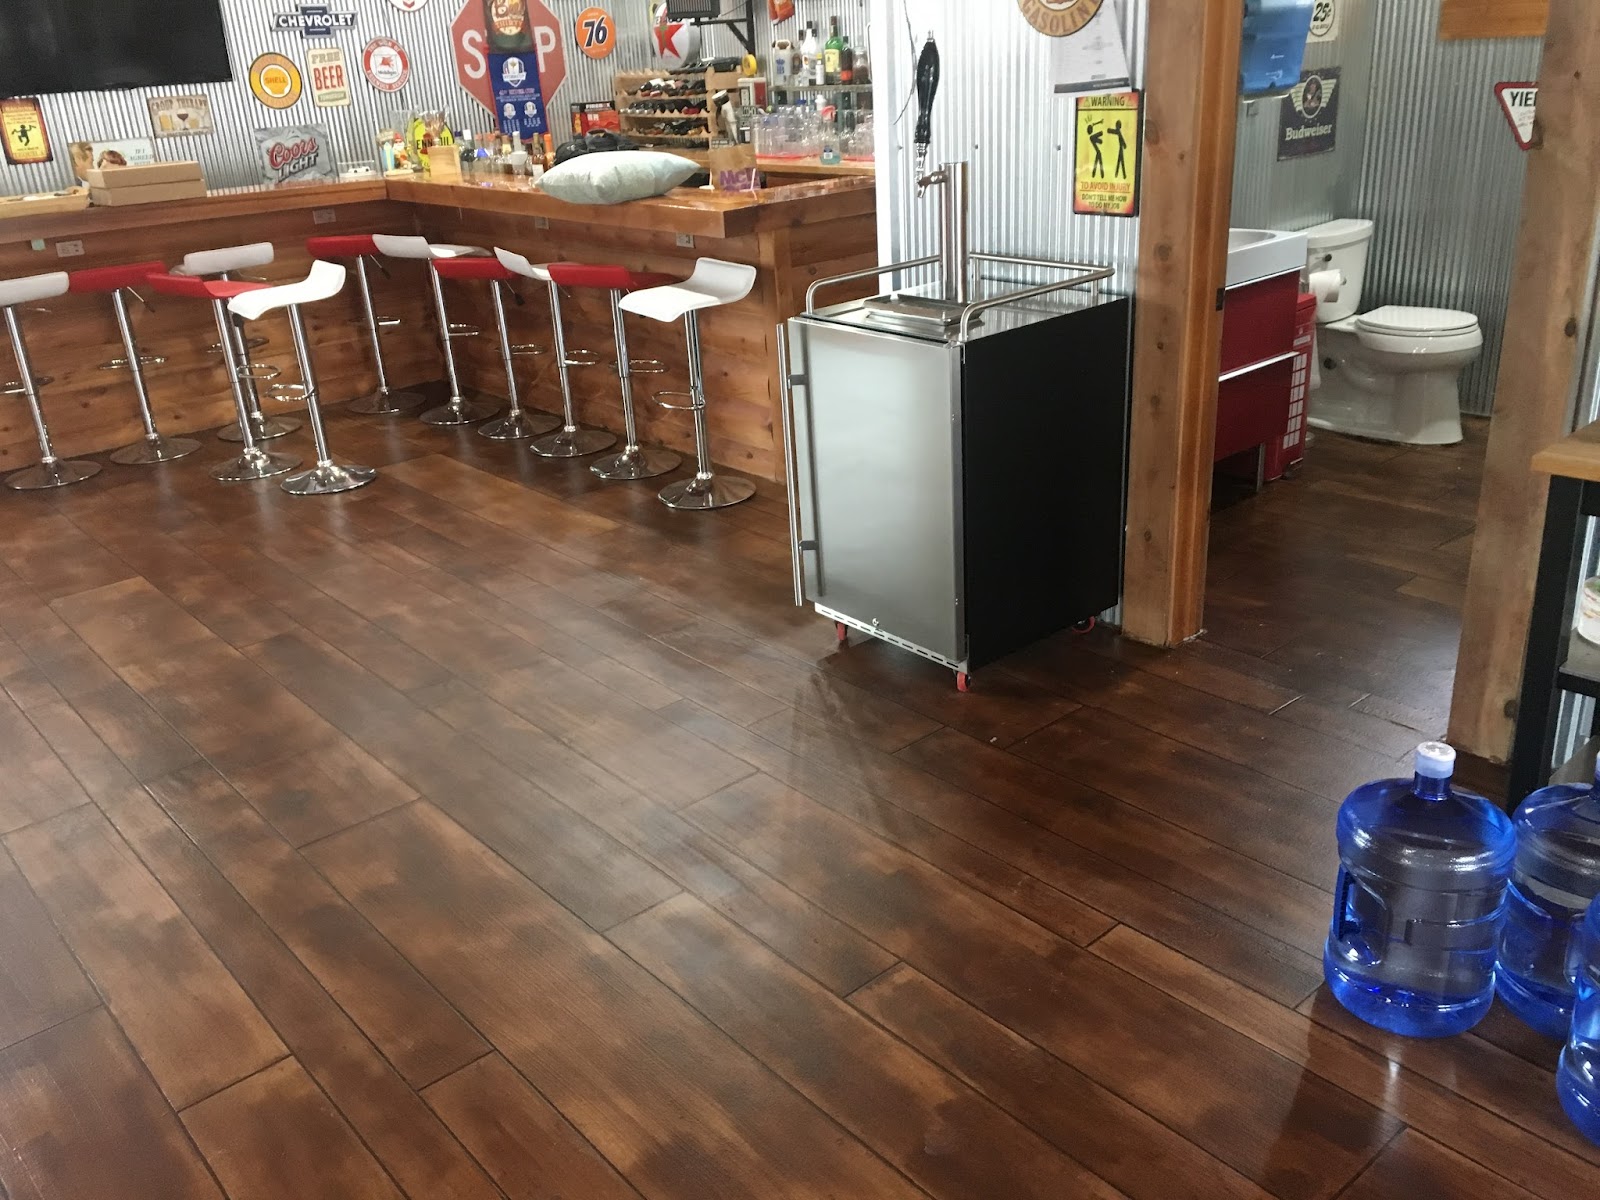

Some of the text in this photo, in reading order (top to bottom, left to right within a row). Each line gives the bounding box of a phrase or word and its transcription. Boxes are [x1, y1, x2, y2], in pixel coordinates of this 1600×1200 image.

[278, 13, 353, 27] CHEVROLET
[582, 15, 608, 48] 76
[311, 51, 340, 65] FREE
[462, 26, 557, 80] SP
[264, 76, 287, 84] SHELL
[313, 64, 345, 90] BEER
[1091, 96, 1125, 107] WARNING
[1510, 91, 1537, 107] YIE
[1285, 122, 1332, 141] Budweiser
[266, 137, 319, 170] Coors
[278, 152, 319, 182] LIGHT
[1080, 181, 1131, 192] TO AVOID INJURY
